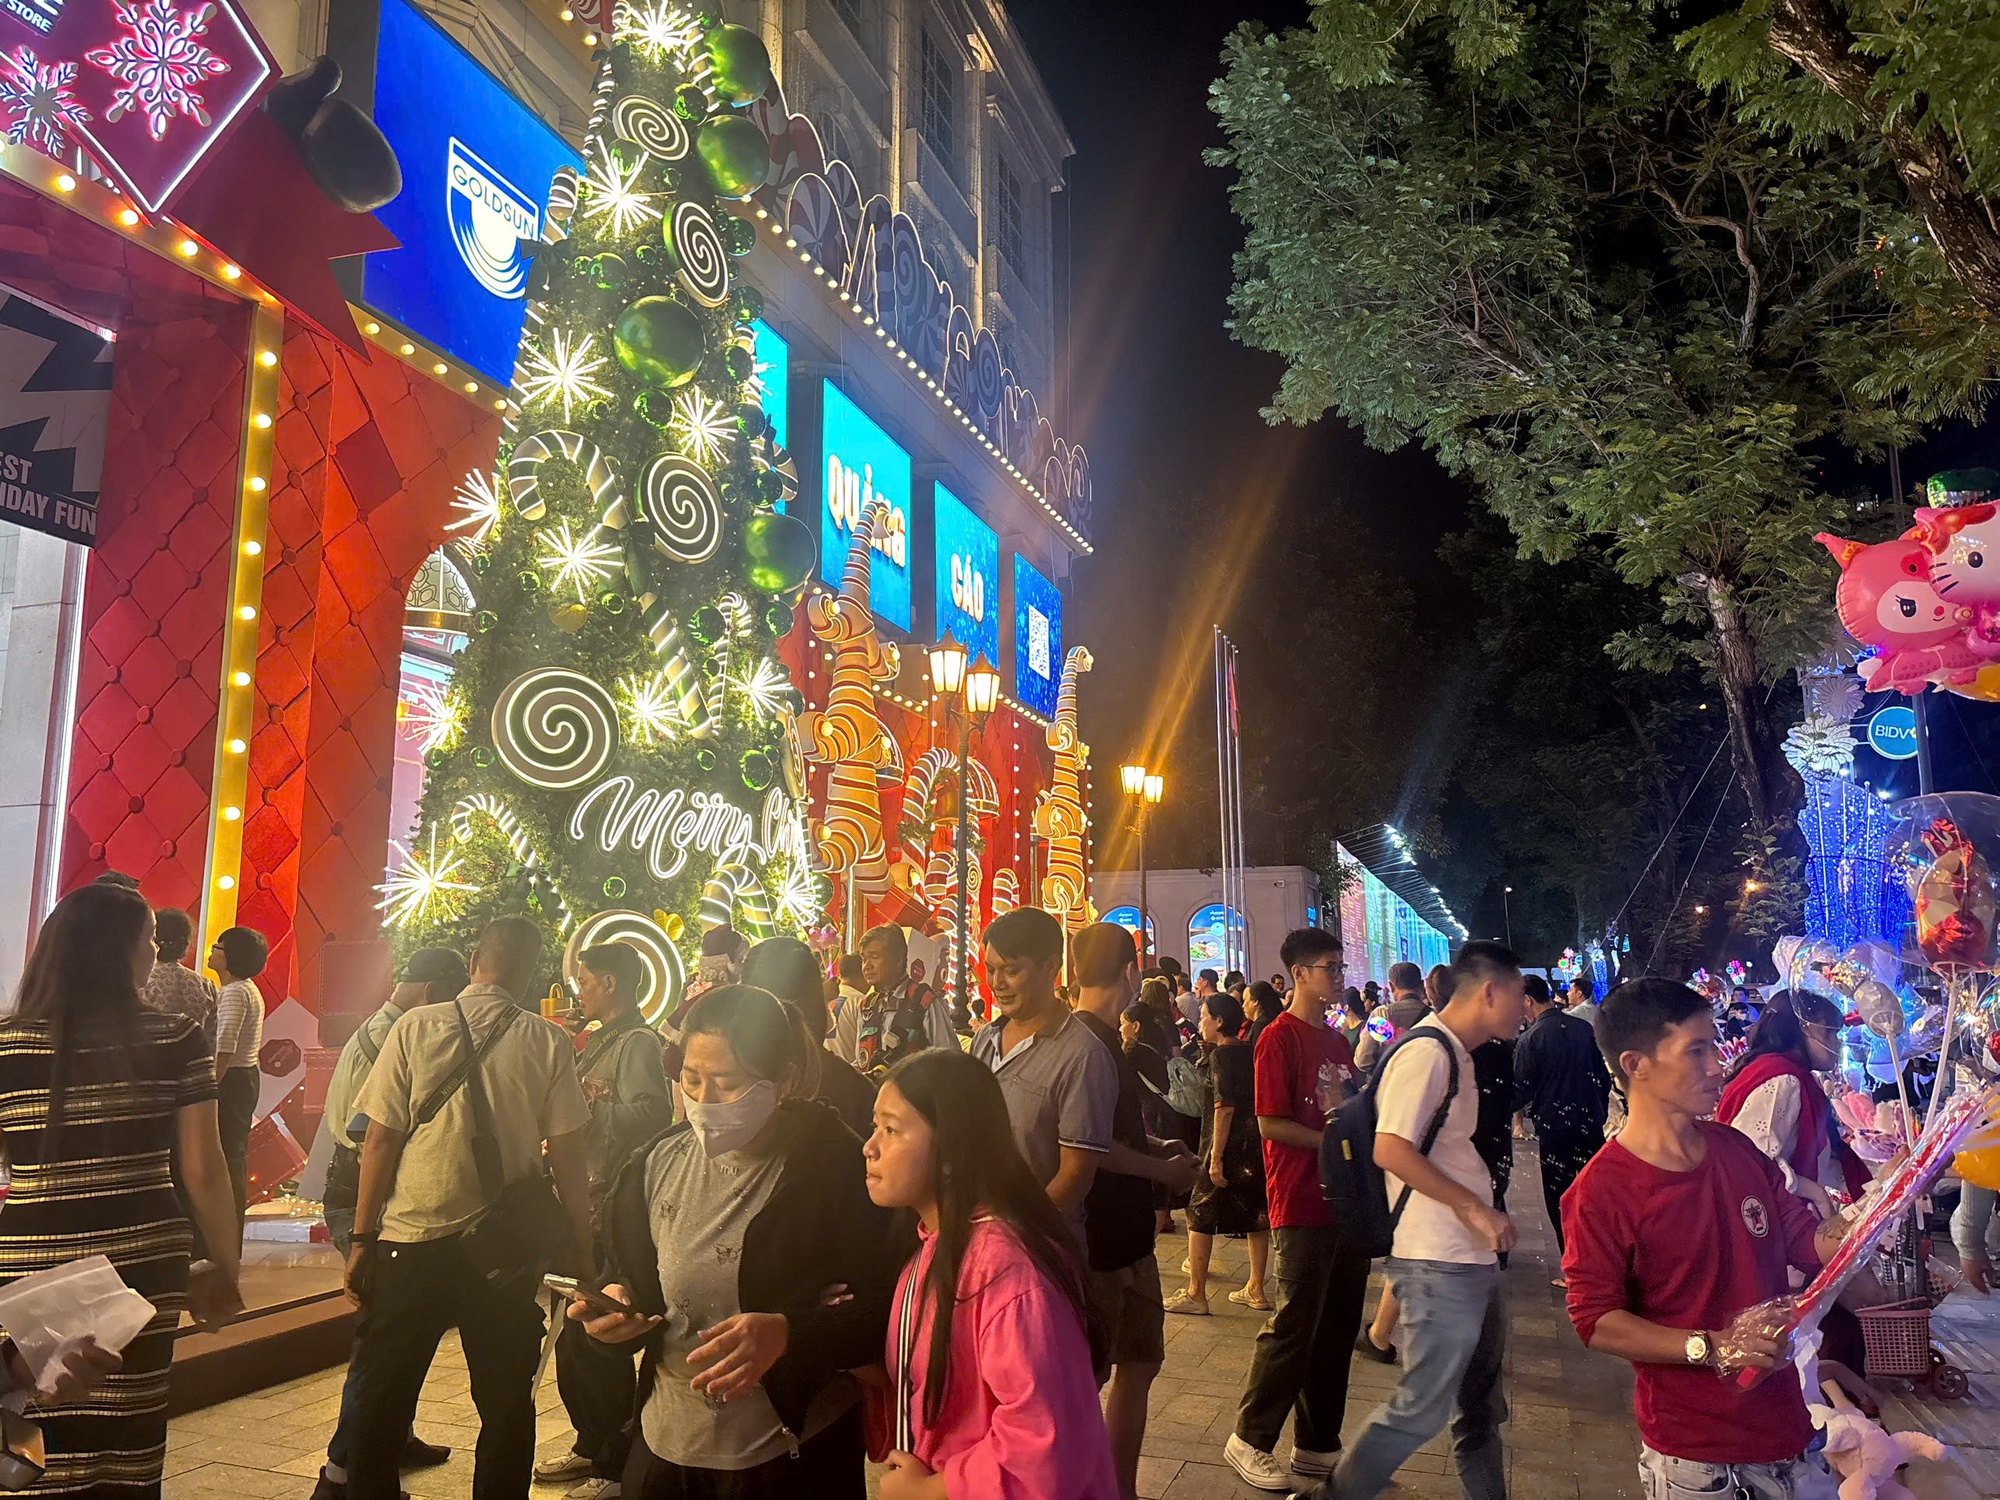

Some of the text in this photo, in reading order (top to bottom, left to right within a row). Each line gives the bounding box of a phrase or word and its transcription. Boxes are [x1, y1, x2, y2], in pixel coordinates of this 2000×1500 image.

[6, 0, 53, 33] STORE
[452, 164, 534, 239] GOLDSUN
[54, 499, 97, 536] FUN
[951, 553, 984, 623] CÁO
[1875, 724, 1911, 740] BIDV
[570, 775, 767, 879] Merry
